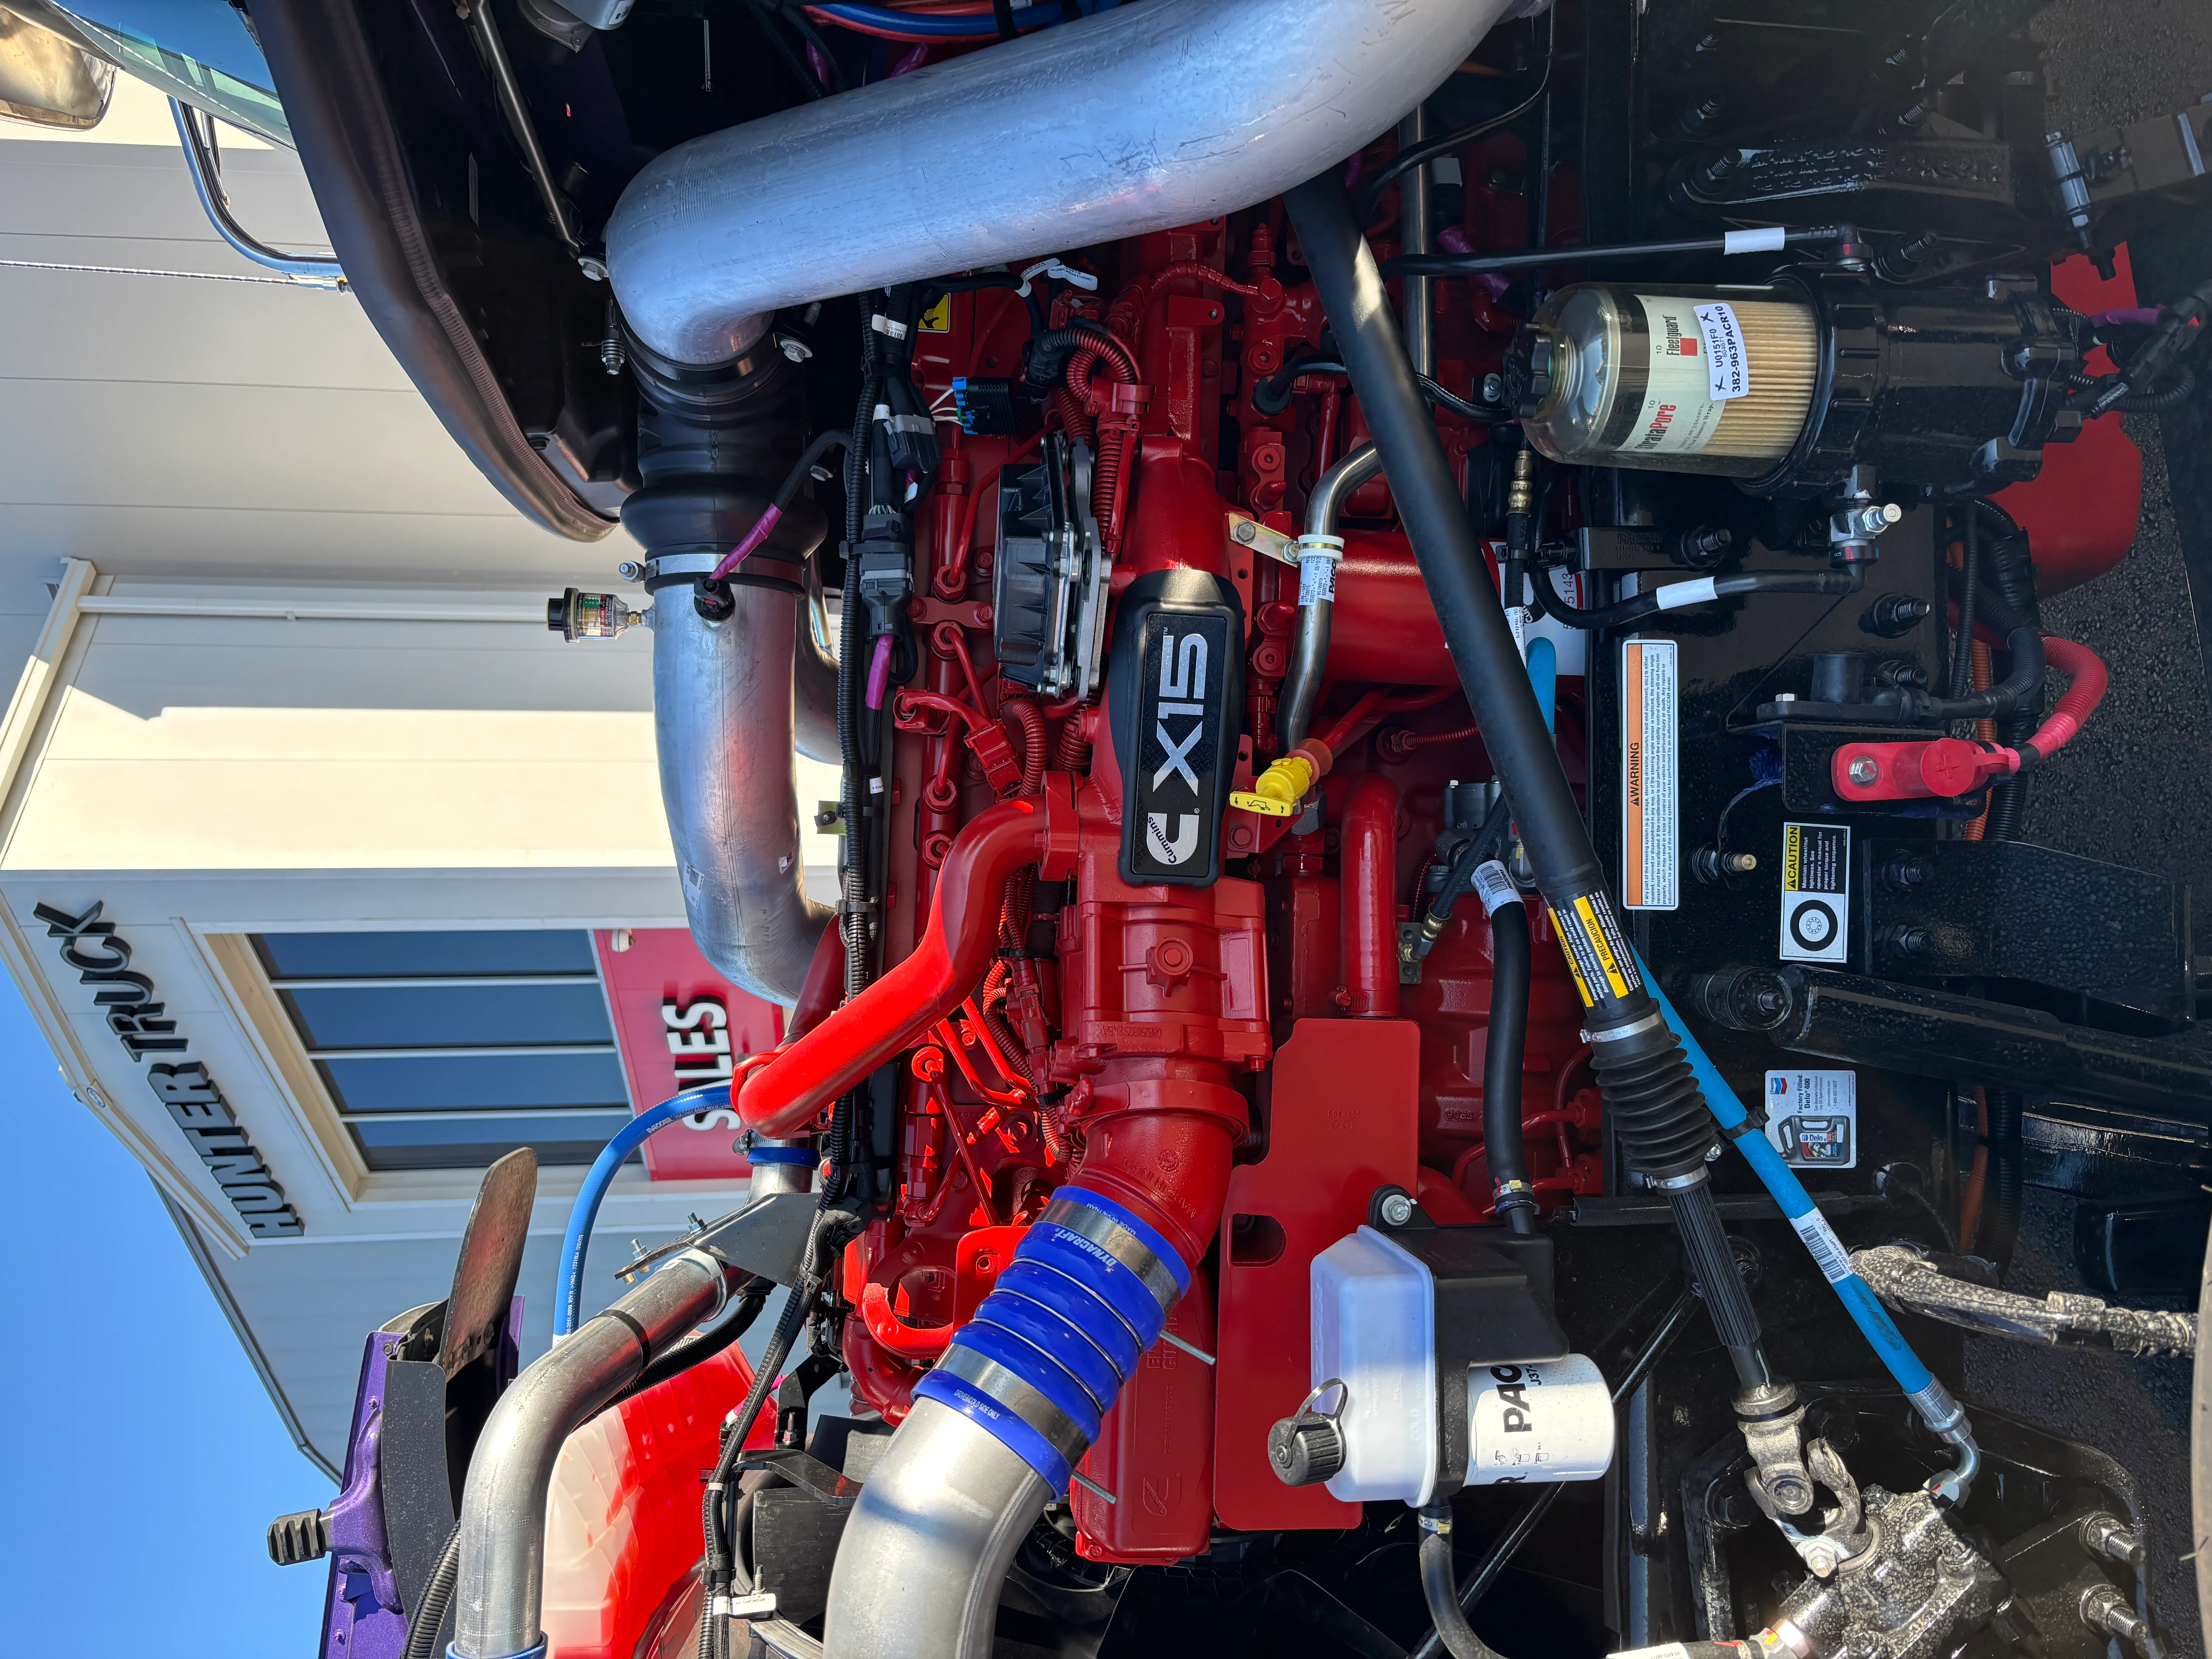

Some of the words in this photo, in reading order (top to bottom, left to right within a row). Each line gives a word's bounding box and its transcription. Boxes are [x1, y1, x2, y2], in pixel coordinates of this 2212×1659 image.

[1656, 345, 1662, 355] 10
[1663, 316, 1682, 356] Fleetguard
[1709, 329, 1723, 368] U0151F0
[1715, 306, 1740, 392] 382-963PACR10
[1647, 400, 1655, 409] 10
[1702, 403, 1714, 421] Wrap.
[1634, 404, 1676, 450] StrataPore
[1561, 573, 1575, 630] 55143
[1152, 633, 1208, 796] X15
[1630, 743, 1639, 797] WARNING
[1146, 816, 1177, 864] Cummins
[1788, 827, 1797, 879] CAUTION
[1559, 936, 1573, 964] CAUTION
[1586, 919, 1609, 961] PRECAUCION
[33, 901, 188, 1062] TRUCK
[646, 1117, 672, 1133] PACCAR
[147, 1061, 305, 1237] HUNTER
[1087, 1203, 1111, 1218] VIETNAM
[1119, 1221, 1136, 1235] MADE
[1056, 1229, 1117, 1266] DYNACRAFT
[1525, 1365, 1542, 1386] J37-
[978, 1403, 990, 1413] SIDE
[987, 1409, 1000, 1420] ONLY
